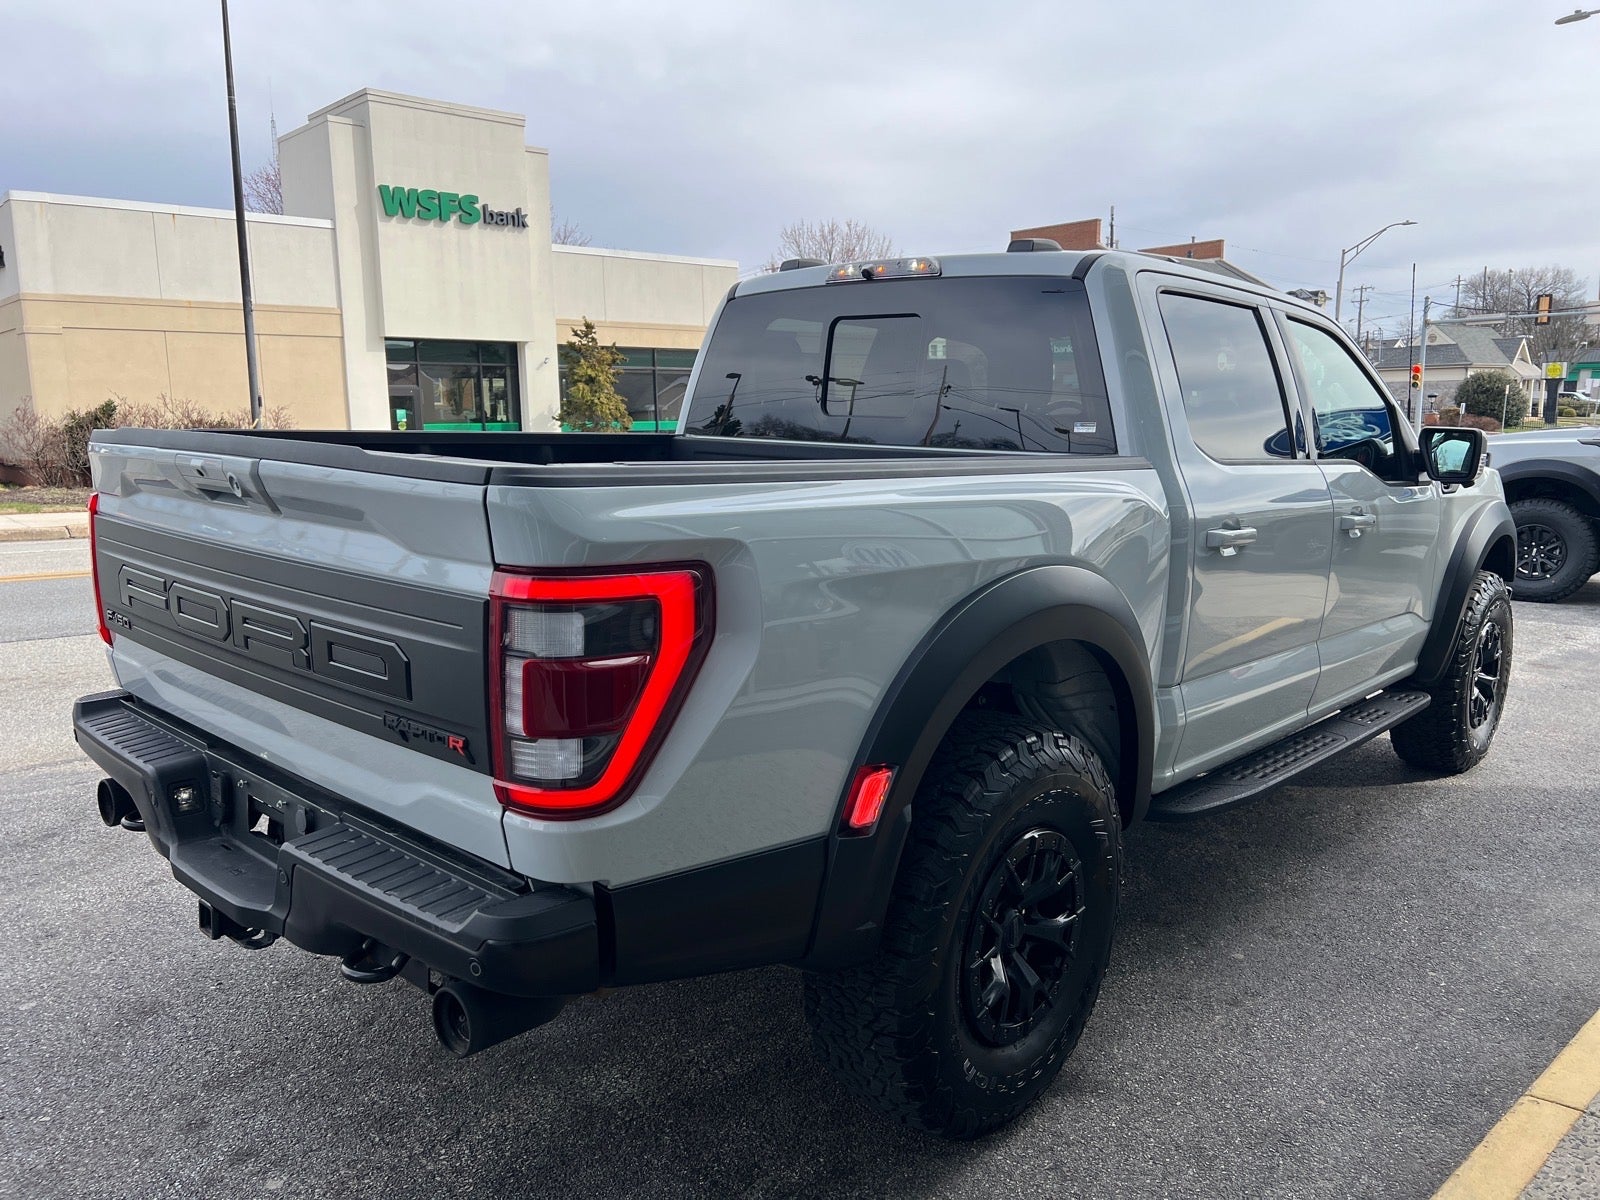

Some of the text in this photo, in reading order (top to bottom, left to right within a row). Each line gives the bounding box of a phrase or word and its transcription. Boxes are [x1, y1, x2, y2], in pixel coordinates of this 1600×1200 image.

[379, 185, 528, 228] WSFS bank
[118, 564, 412, 701] FORD
[383, 711, 472, 761] RAPTOR
